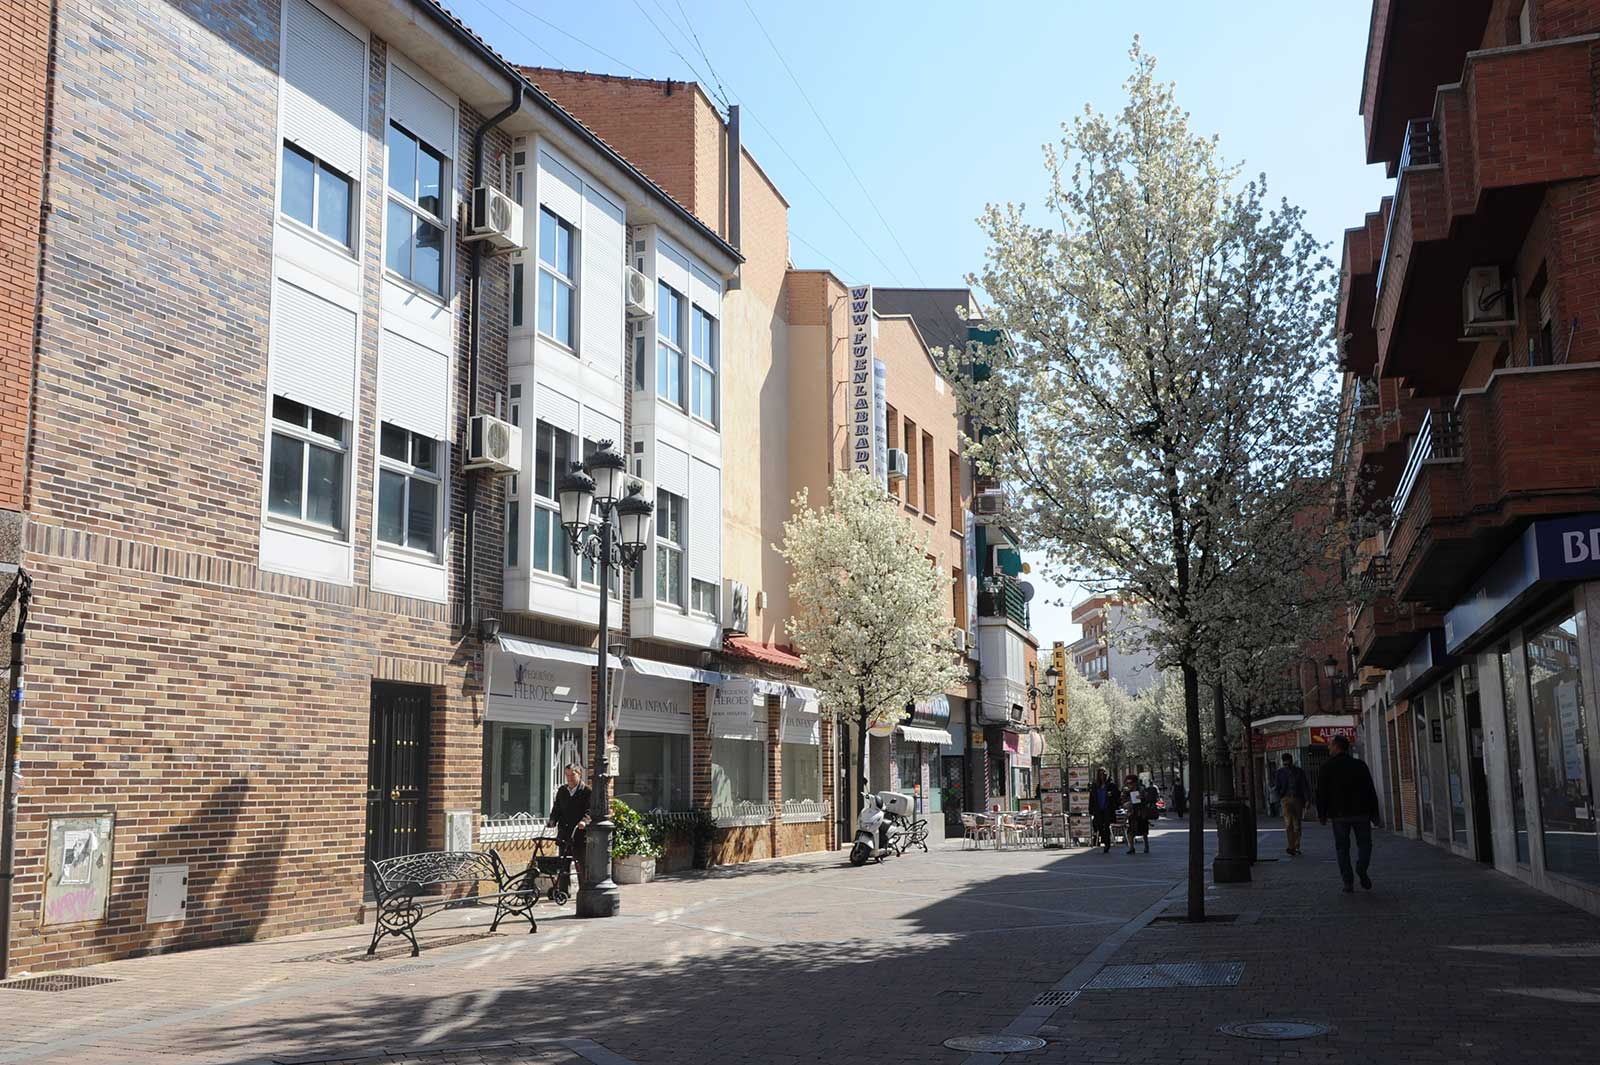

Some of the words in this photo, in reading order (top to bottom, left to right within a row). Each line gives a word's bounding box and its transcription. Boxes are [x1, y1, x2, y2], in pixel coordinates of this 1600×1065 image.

[513, 680, 555, 702] HEROES
[1055, 642, 1066, 724] PELETERIA
[713, 695, 750, 705] HEROES
